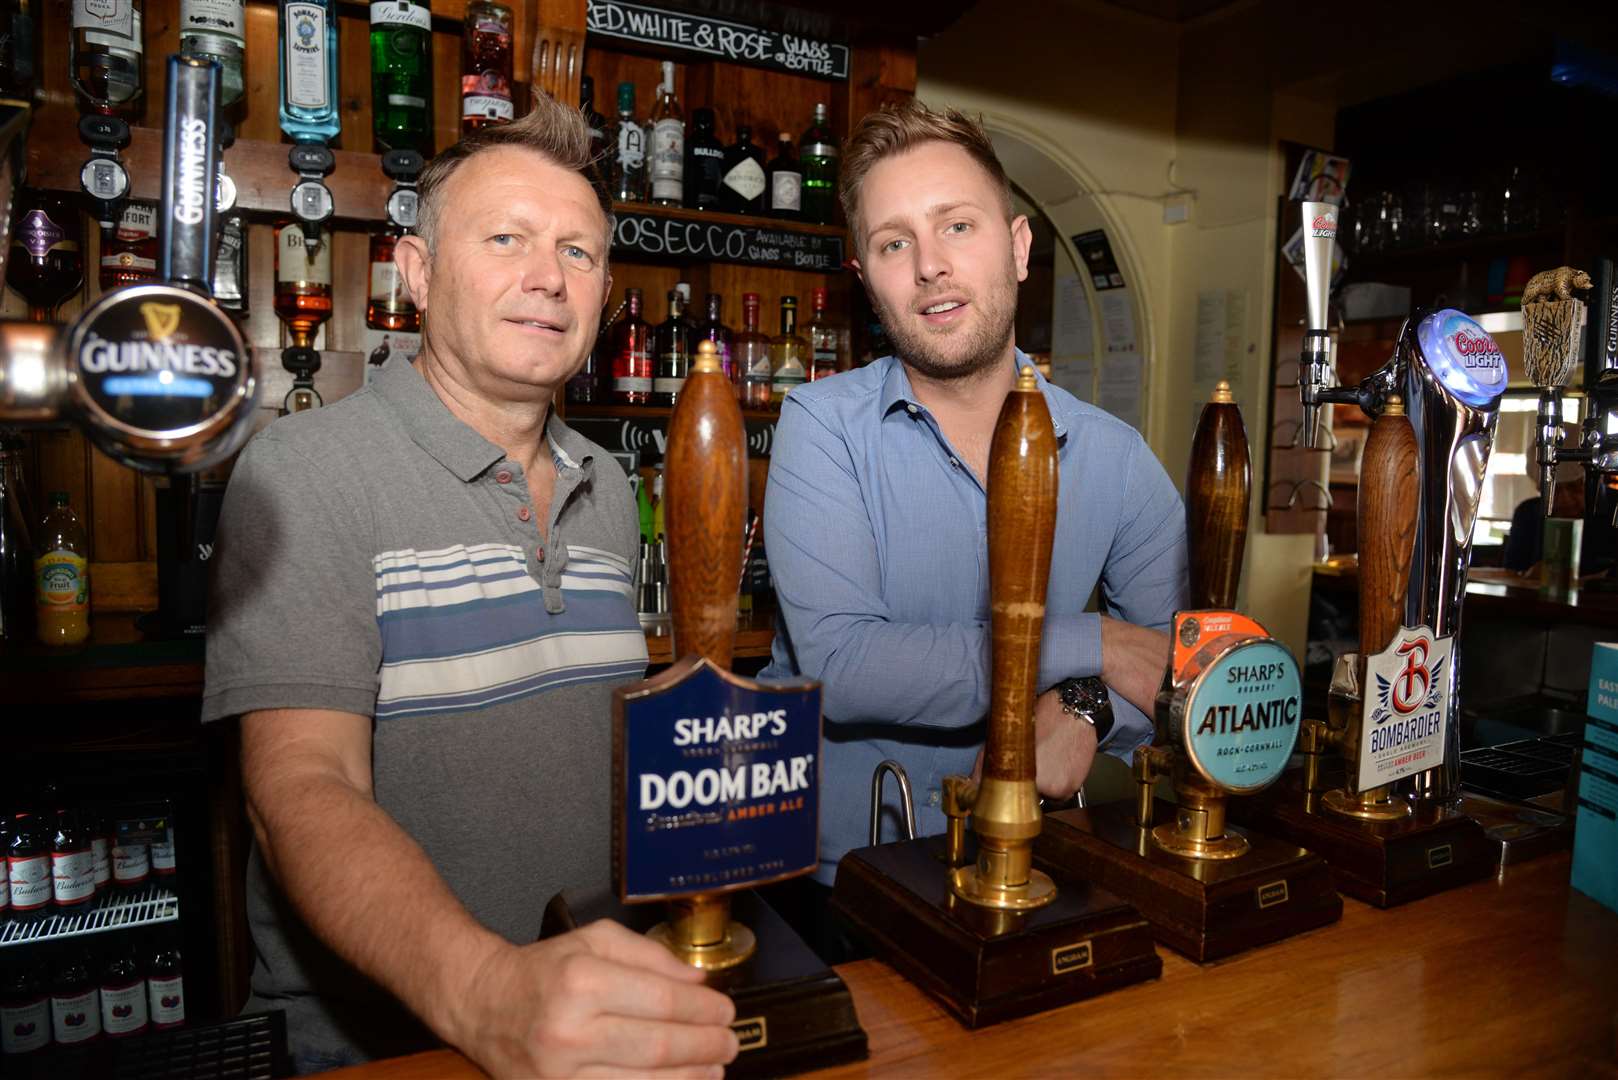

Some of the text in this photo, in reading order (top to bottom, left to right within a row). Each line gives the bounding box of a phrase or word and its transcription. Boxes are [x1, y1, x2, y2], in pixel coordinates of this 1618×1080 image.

[627, 11, 692, 42] WHITE
[693, 24, 714, 48] &
[782, 34, 830, 59] GLASS
[785, 53, 834, 75] BOTTLE
[174, 119, 207, 224] GUINNESS
[80, 338, 237, 378] GUINNESS
[1456, 331, 1499, 355] Coors
[1465, 354, 1500, 369] LIGHT
[1227, 662, 1285, 684] SHARP'S
[673, 709, 788, 747] SHARP'S
[1197, 696, 1298, 736] ATLANTIC
[1370, 710, 1441, 754] BOMBARDIER
[639, 766, 747, 811] DOOM
[727, 802, 776, 822] AMBER
[779, 796, 805, 813] ALE
